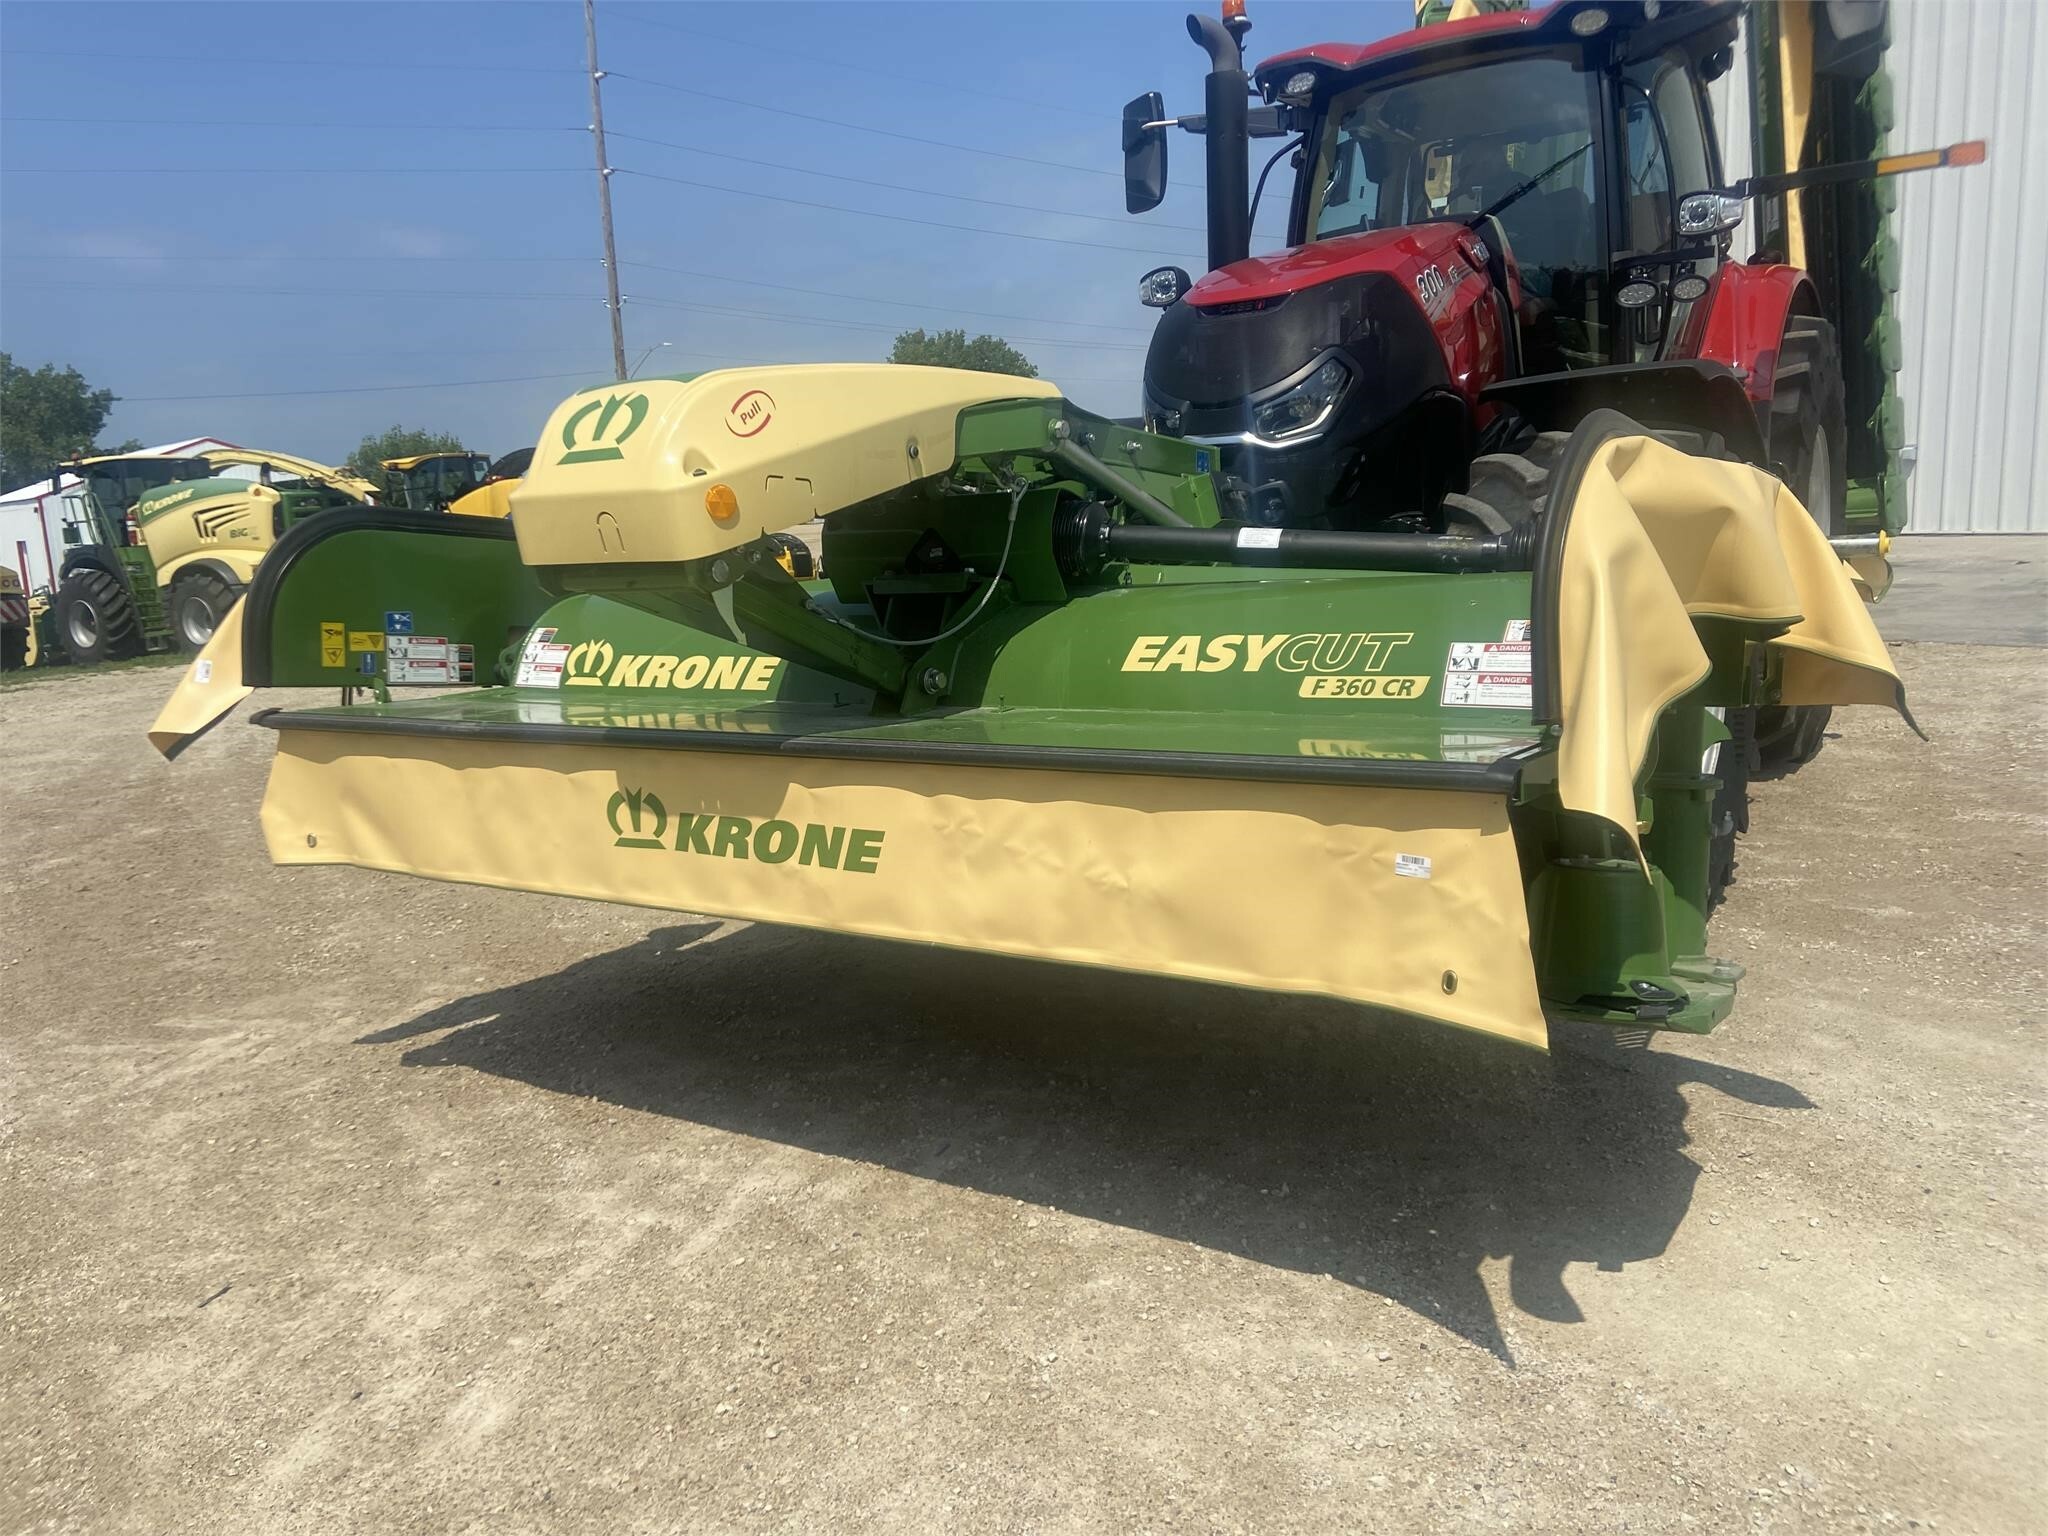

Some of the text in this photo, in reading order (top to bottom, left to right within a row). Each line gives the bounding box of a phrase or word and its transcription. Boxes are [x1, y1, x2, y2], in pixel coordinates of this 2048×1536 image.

[740, 400, 762, 425] Pull
[1120, 632, 1414, 672] EASYCUT
[607, 655, 781, 691] KRONE
[1311, 678, 1415, 696] F 360 CR
[1493, 676, 1528, 684] DANGER
[675, 812, 886, 874] KRONE
